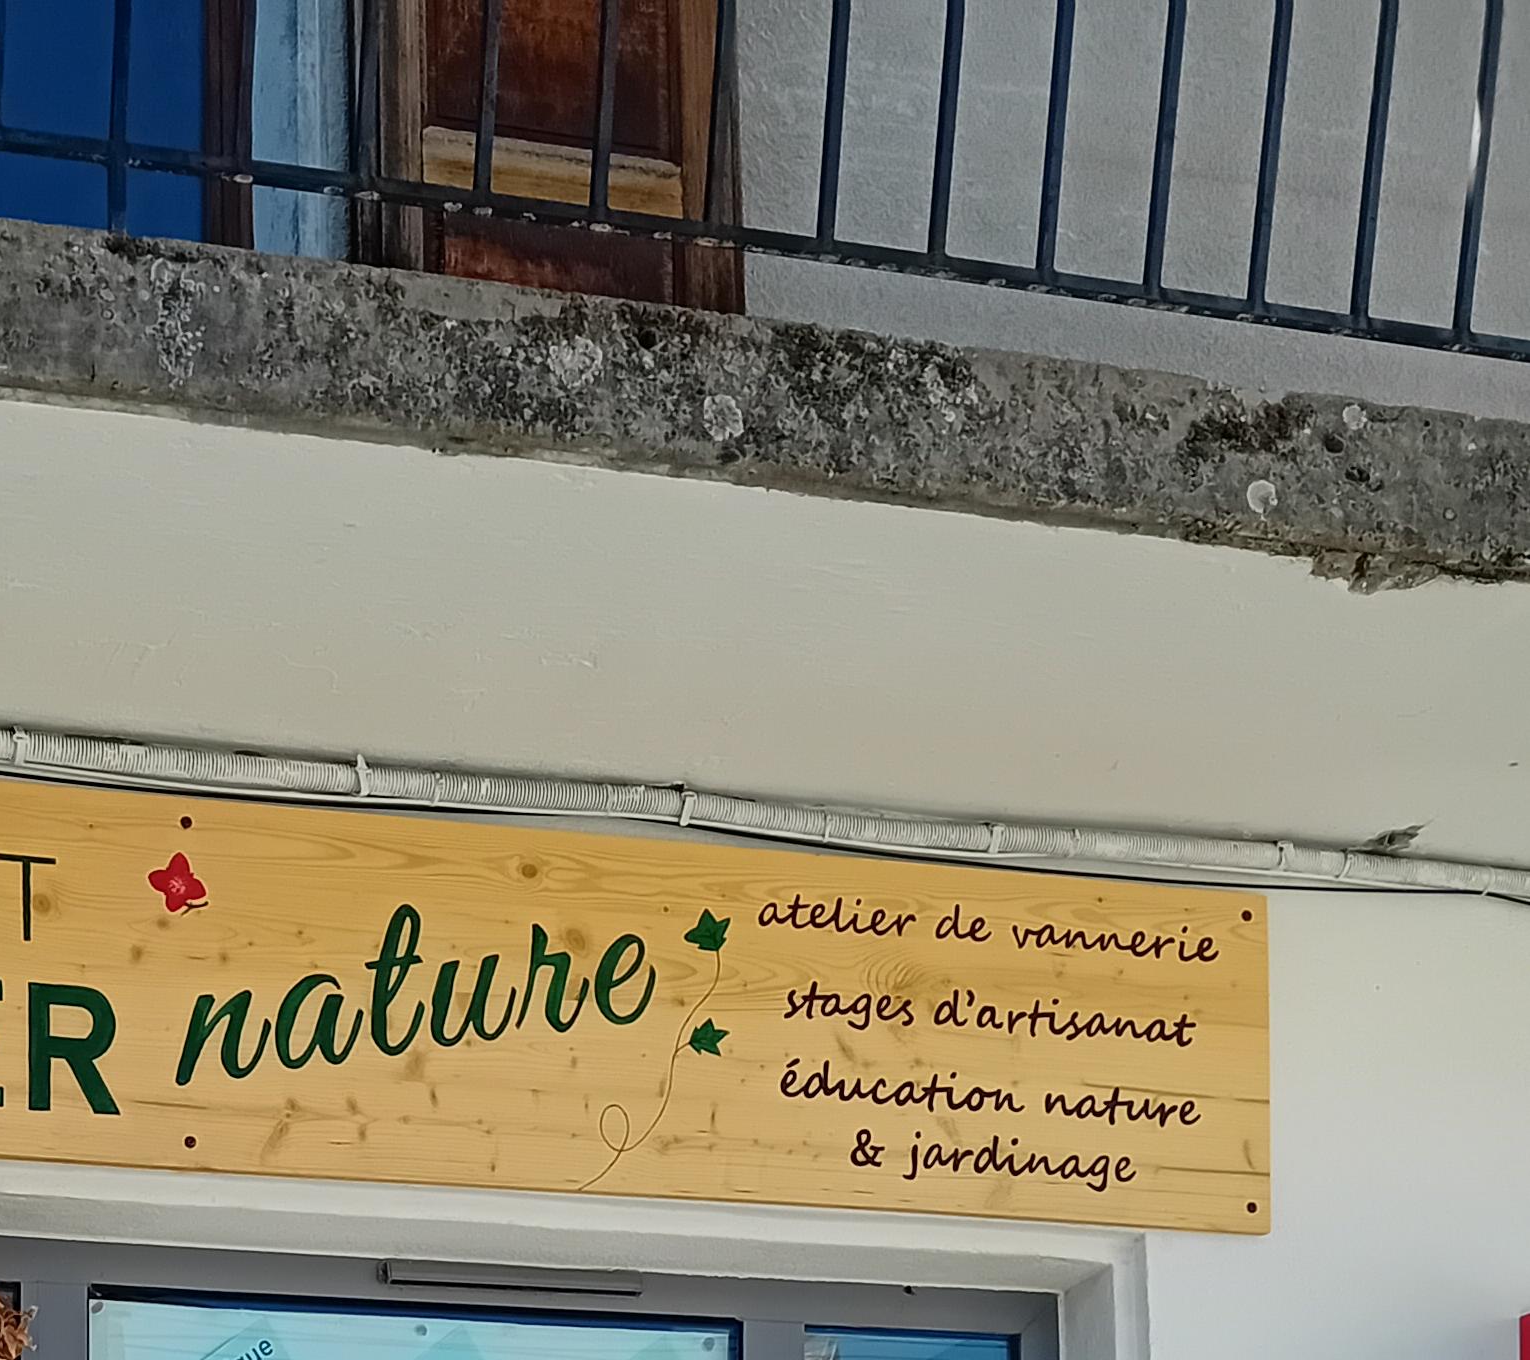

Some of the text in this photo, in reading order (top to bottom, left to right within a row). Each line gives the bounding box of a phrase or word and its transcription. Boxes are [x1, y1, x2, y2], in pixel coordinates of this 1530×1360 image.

[758, 894, 1220, 964] atelier de vannerie
[175, 903, 656, 1087] nature
[783, 981, 1196, 1047] stages d'artisanat
[779, 1058, 1201, 1128] éducation nature
[850, 1129, 1136, 1192] & jardinage
